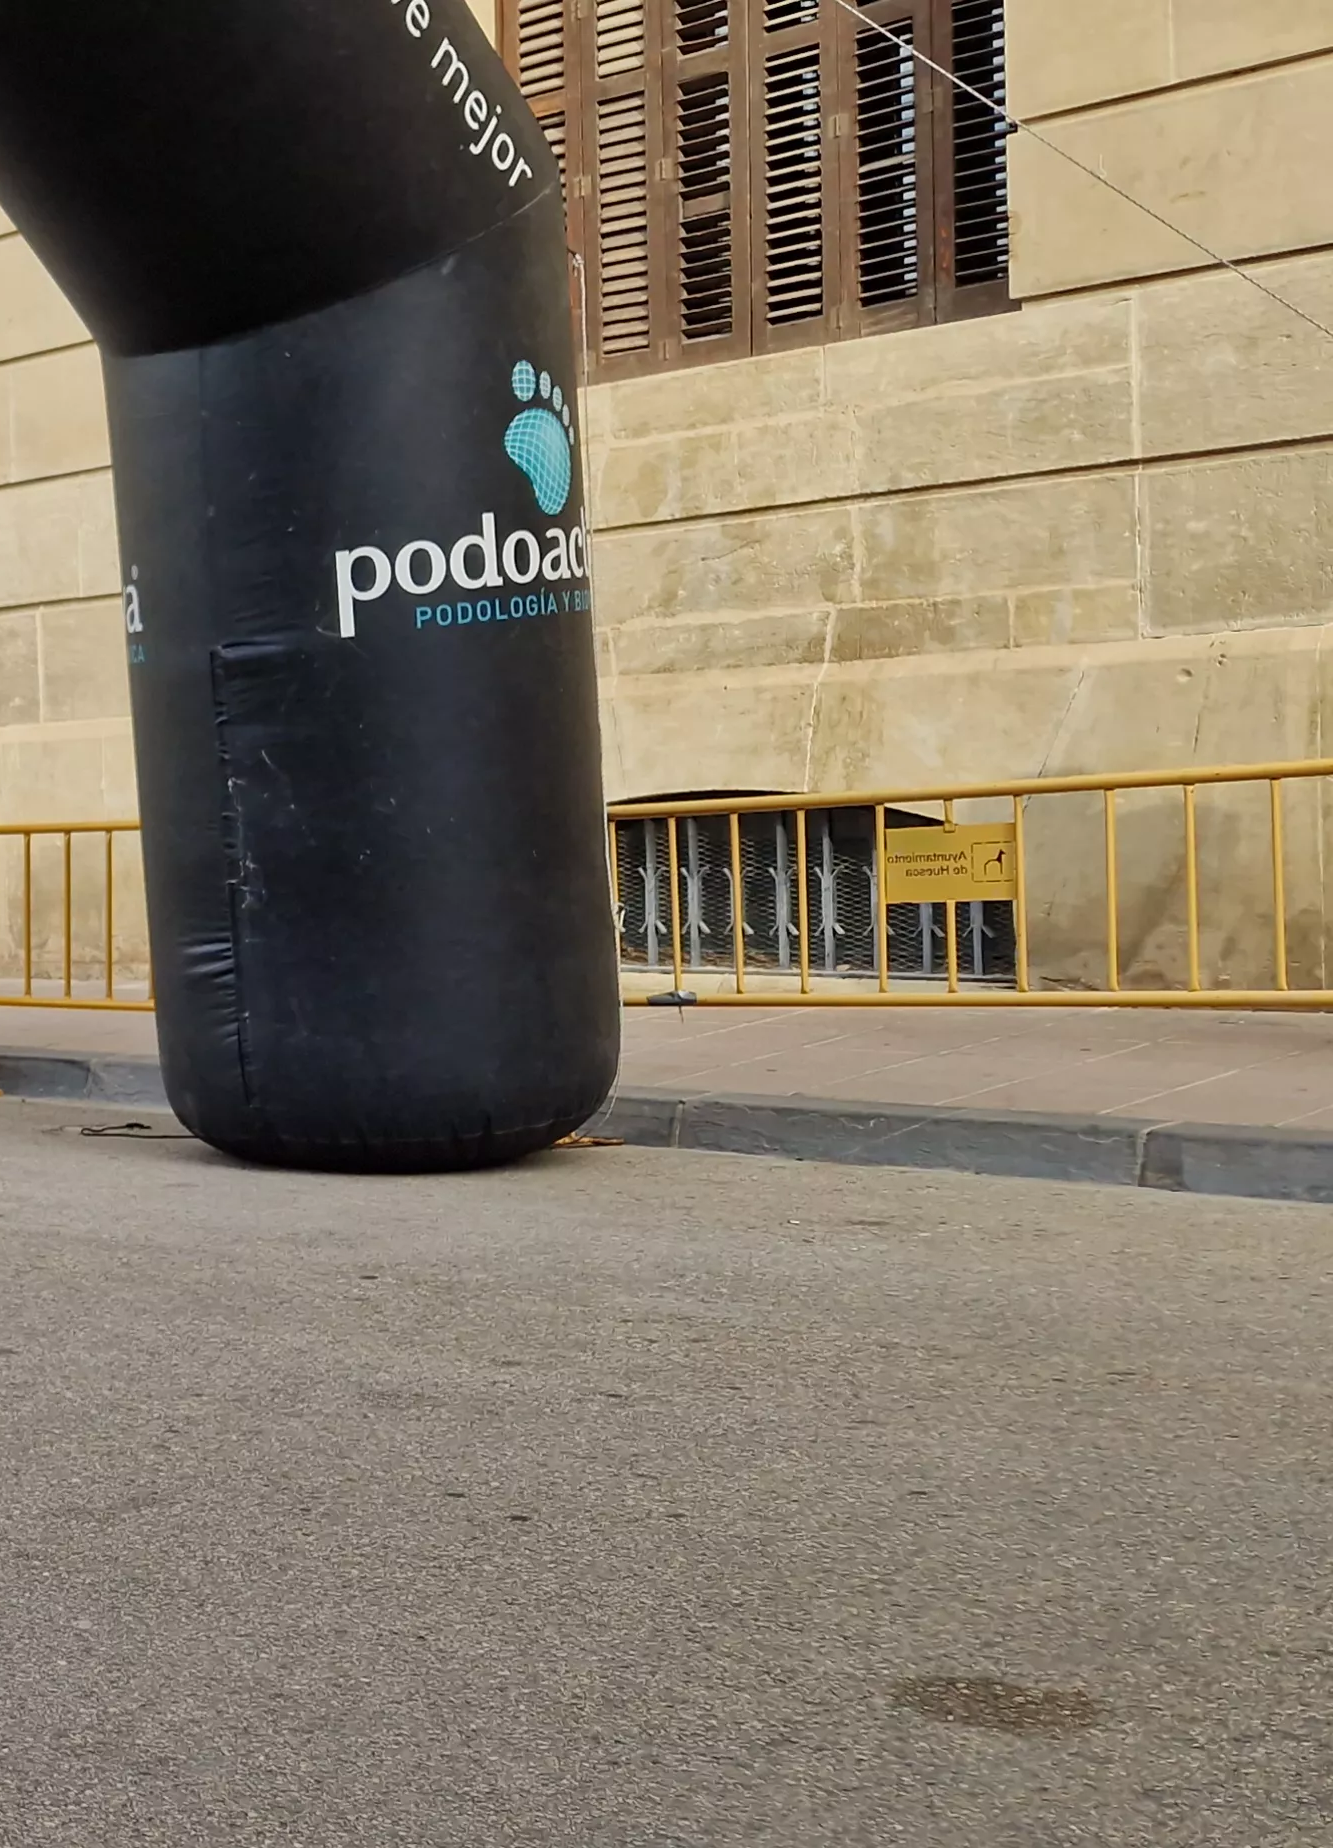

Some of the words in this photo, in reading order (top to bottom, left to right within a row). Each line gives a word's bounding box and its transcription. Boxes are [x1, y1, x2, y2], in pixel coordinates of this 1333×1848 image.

[430, 37, 533, 187] mejor
[415, 587, 558, 629] PODOLOGÍA
[562, 591, 571, 612] Y
